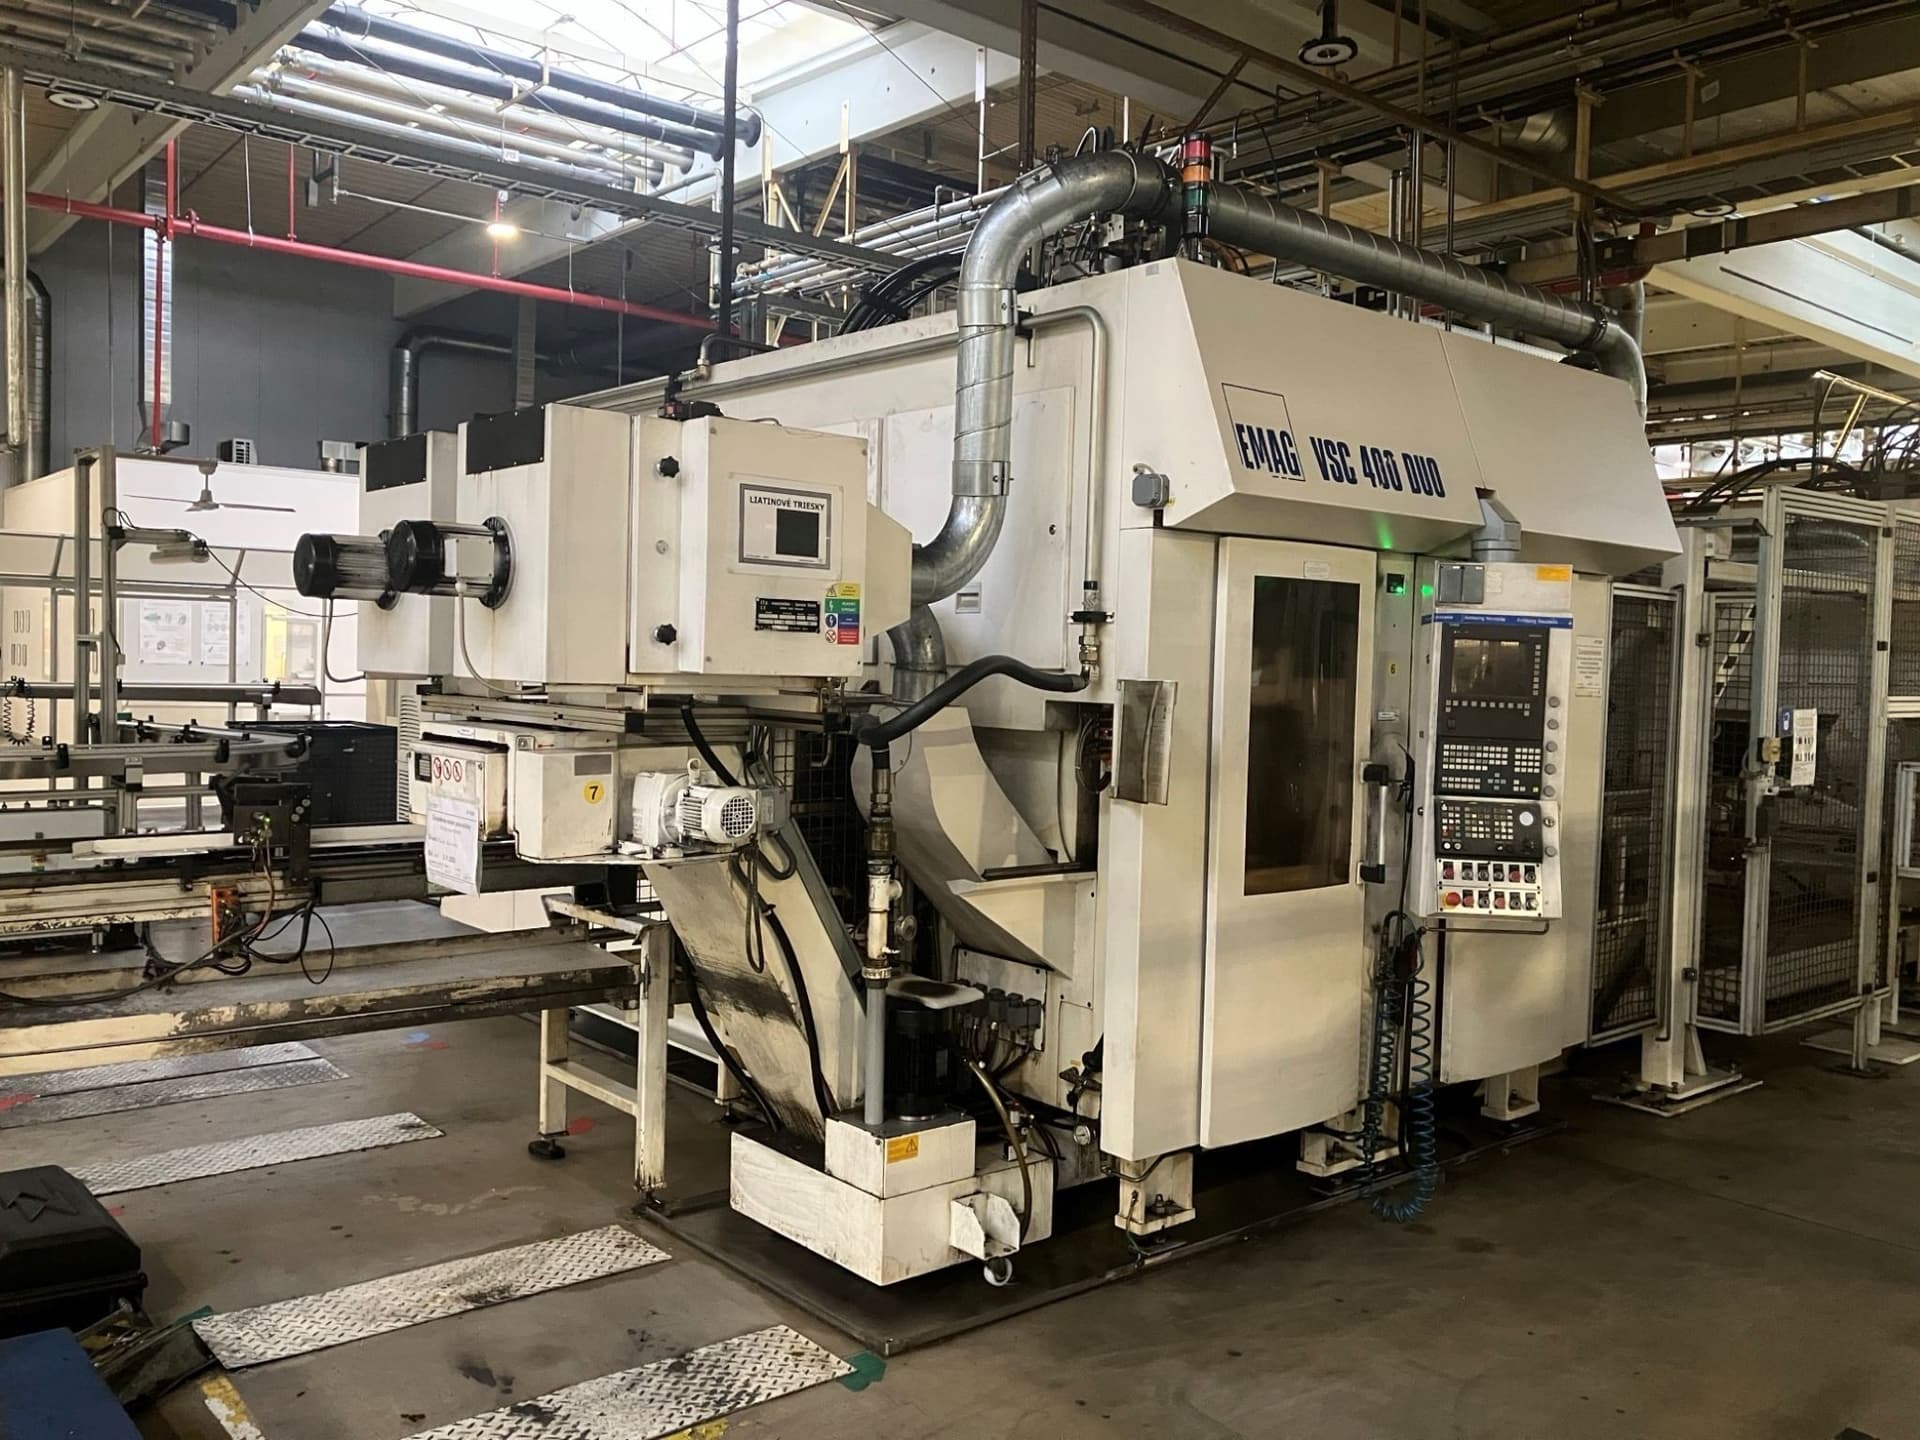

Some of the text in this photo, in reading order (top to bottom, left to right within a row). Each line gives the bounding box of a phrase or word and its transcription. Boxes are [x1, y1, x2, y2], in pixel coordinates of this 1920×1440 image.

[1235, 423, 1446, 498] EMAG VSC 400 DUO
[749, 495, 825, 511] LIATINOVÉ TRIESKY
[588, 786, 599, 800] 7
